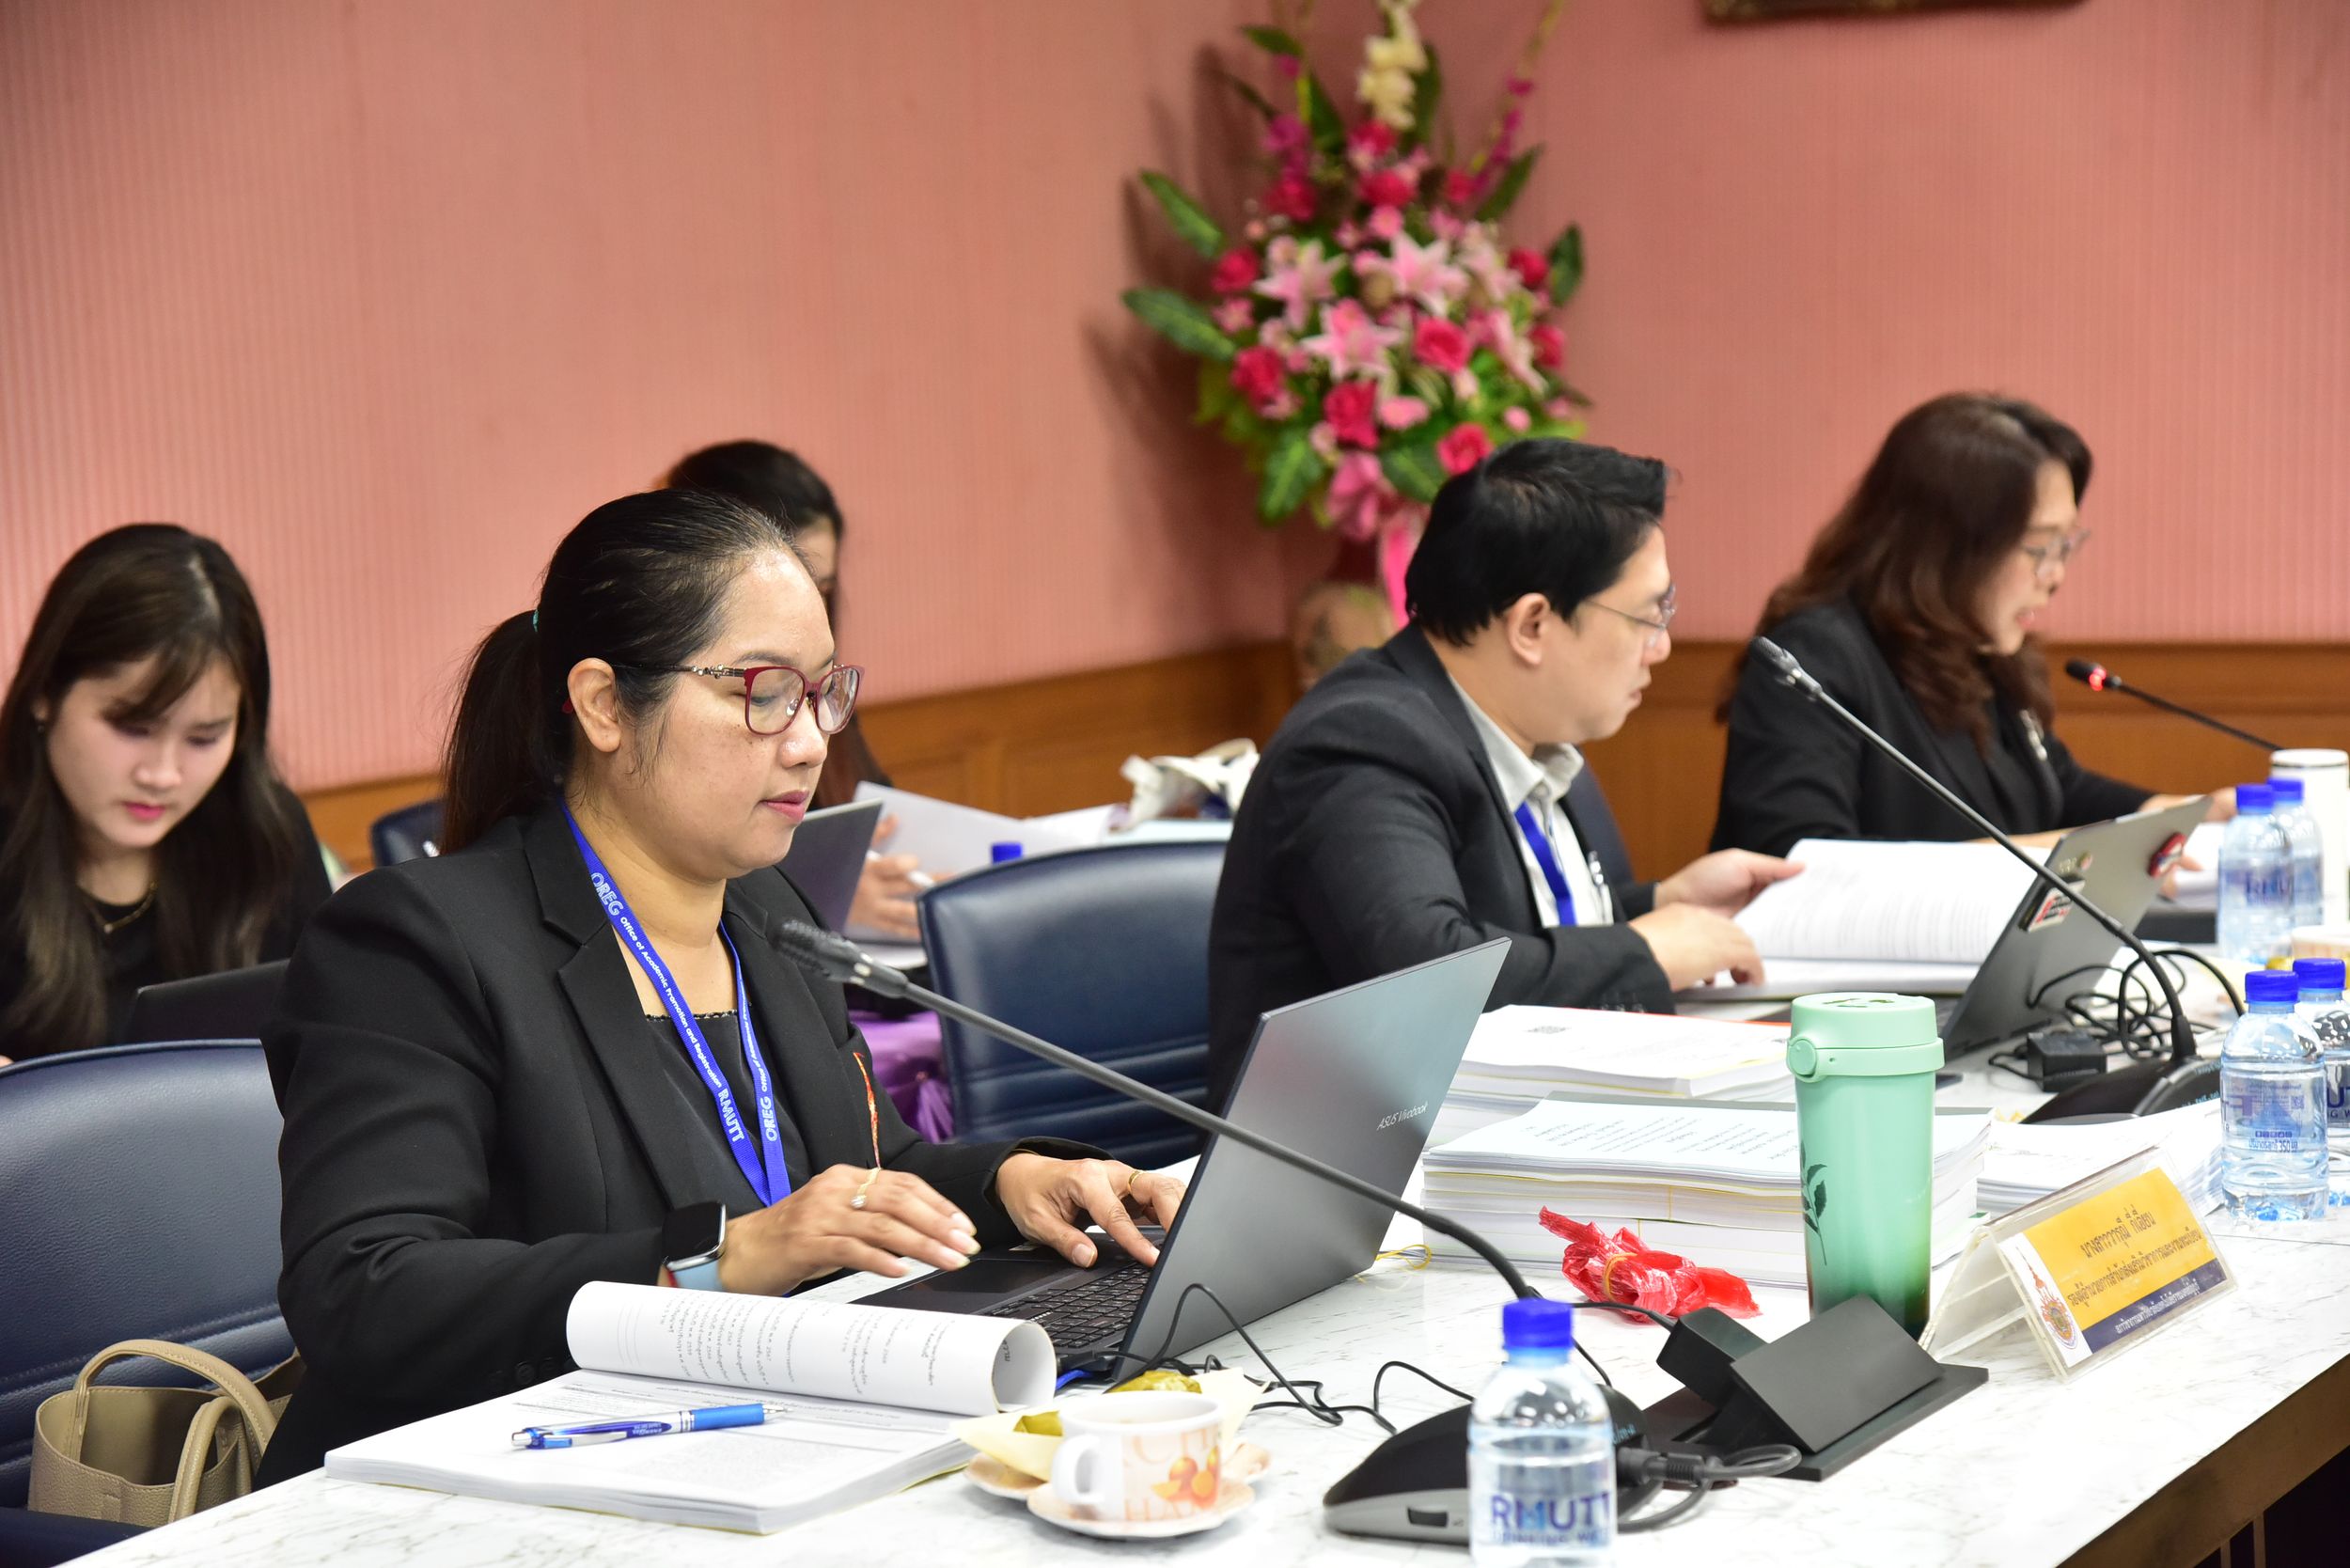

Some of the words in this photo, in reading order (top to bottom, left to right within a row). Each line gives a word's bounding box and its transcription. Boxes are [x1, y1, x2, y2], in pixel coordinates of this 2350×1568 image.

[590, 871, 624, 917] OREG
[620, 917, 637, 941] Office
[635, 935, 645, 951] of
[641, 951, 668, 988] Academic
[666, 987, 689, 1029] Promotion
[686, 1027, 697, 1046] and
[694, 1043, 722, 1089] Registration
[718, 1089, 744, 1142] RMUTT
[763, 1096, 778, 1141] OREG
[1376, 1112, 1399, 1131] ASUS
[1398, 1100, 1429, 1122] Vivobook
